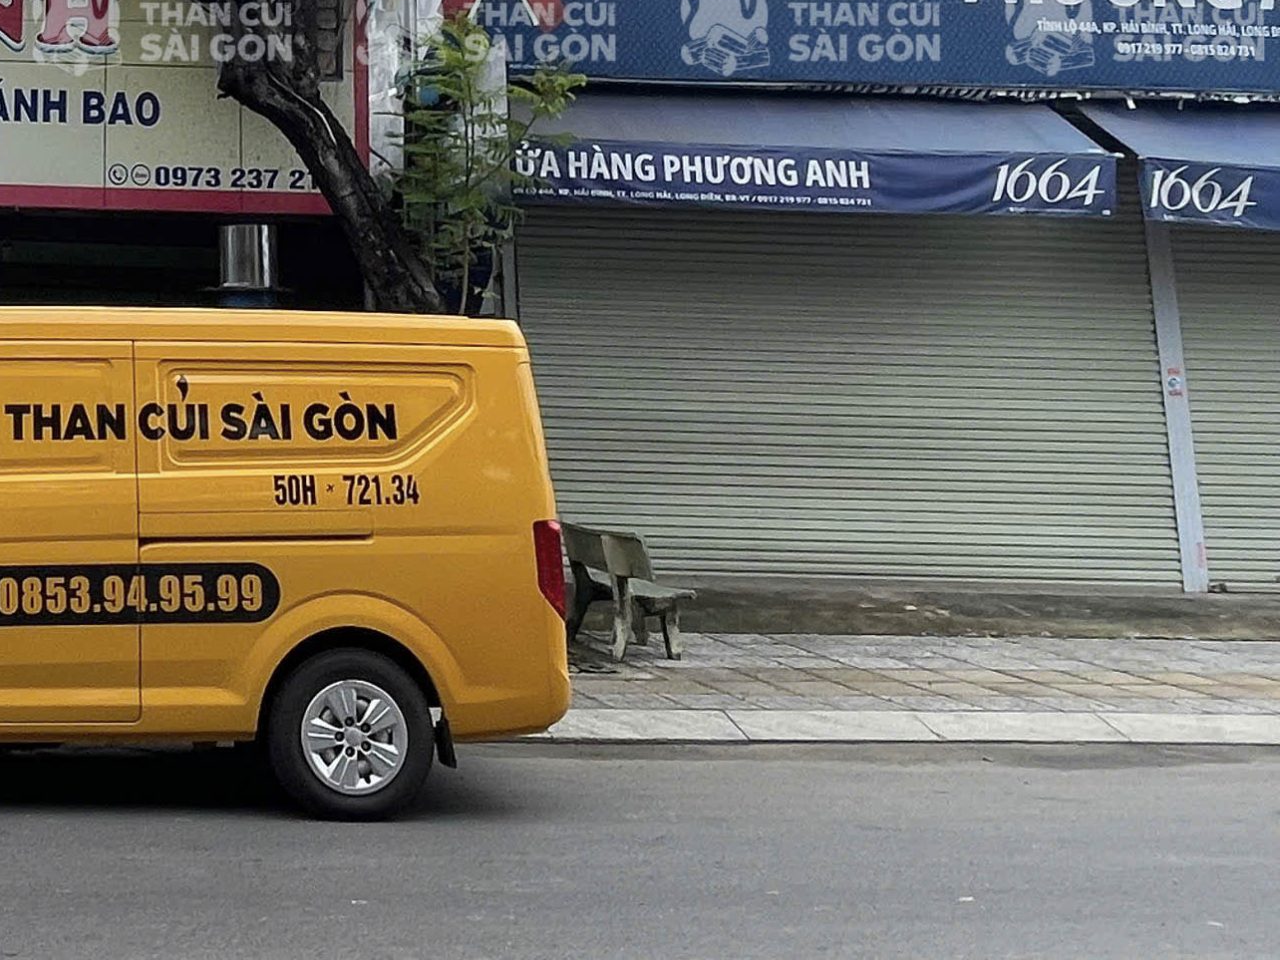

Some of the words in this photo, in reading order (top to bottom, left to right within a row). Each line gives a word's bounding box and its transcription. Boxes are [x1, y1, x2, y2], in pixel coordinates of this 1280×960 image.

[81, 91, 160, 126] BAO
[154, 165, 221, 188] 0973
[231, 168, 280, 189] 237
[289, 169, 319, 190] 21
[514, 140, 561, 178] ỬA
[568, 145, 656, 182] HÀNG
[664, 154, 799, 188] PHƯƠNG
[805, 158, 871, 190] ANH
[992, 157, 1105, 207] 1664
[1150, 165, 1258, 217] 1664
[5, 403, 125, 440] THAN
[138, 375, 209, 440] CỦI
[221, 392, 291, 441] SÀI
[303, 392, 398, 441] GÒN
[274, 475, 317, 506] 50H
[342, 474, 420, 506] 721.34
